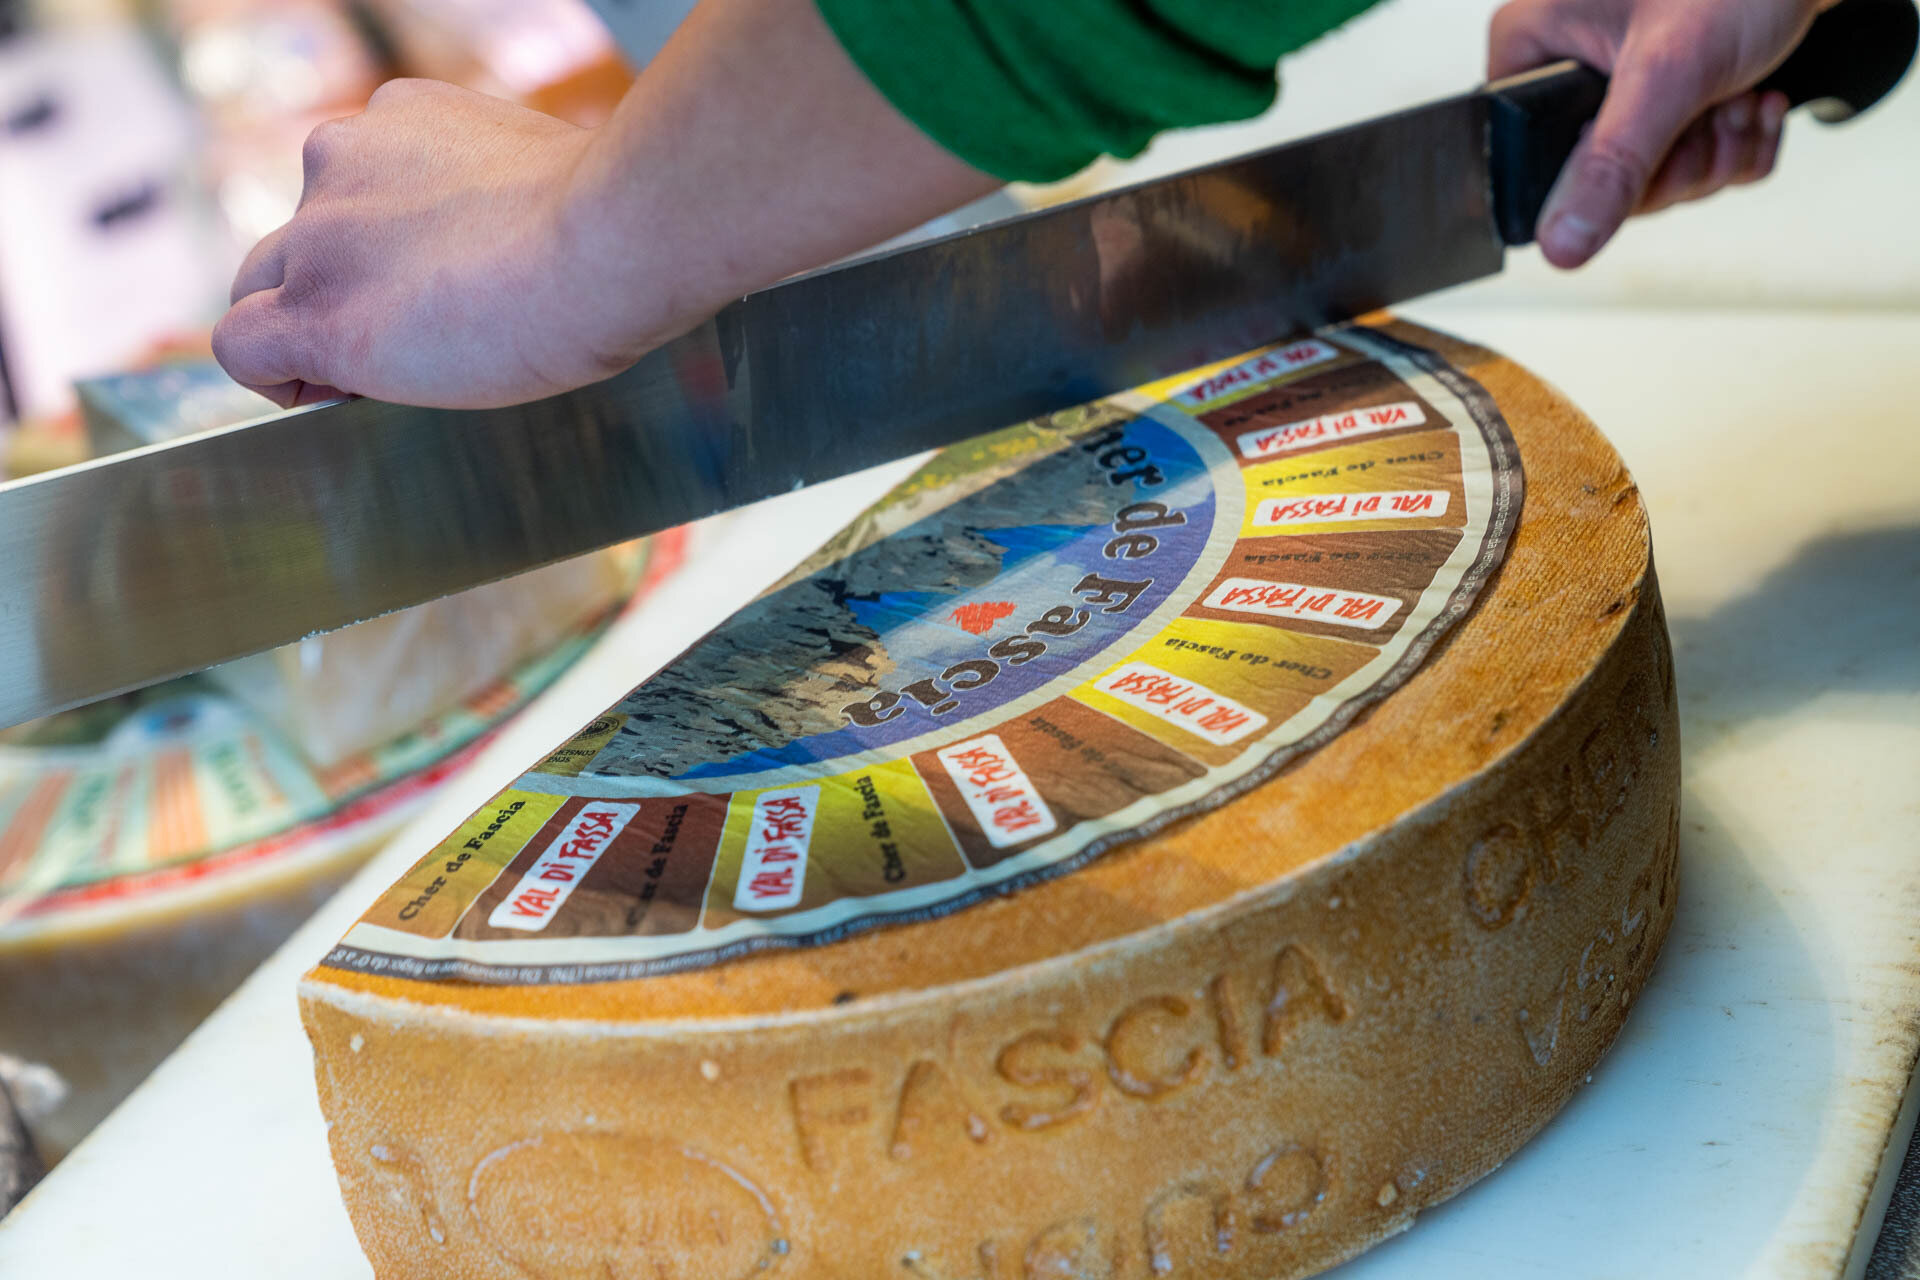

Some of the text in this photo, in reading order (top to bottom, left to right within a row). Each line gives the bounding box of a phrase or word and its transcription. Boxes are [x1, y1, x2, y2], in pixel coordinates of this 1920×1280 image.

[1368, 407, 1408, 425] VAL
[1255, 417, 1326, 451] FASSA
[1261, 466, 1340, 487] Fascia
[1270, 495, 1348, 522] FASSA
[1391, 494, 1433, 513] VAL
[1103, 500, 1188, 561] de
[1220, 585, 1307, 609] FASSA
[1333, 598, 1385, 621] VAL
[838, 572, 1156, 728] Fascia
[1164, 638, 1333, 680] Cher de Fascia
[1109, 672, 1194, 705] FASSA
[1197, 705, 1250, 735] VAL
[947, 746, 1017, 788] FASSA
[650, 803, 690, 856] Fascia
[762, 796, 808, 844] FASSA
[853, 775, 906, 884] Cher de Fascia
[992, 800, 1043, 834] VAL
[398, 800, 527, 921] Cher de Fascia
[510, 887, 561, 918] VAL
[558, 811, 619, 861] FASSA
[748, 867, 794, 899] VAL
[786, 942, 1352, 1173] FASCIA
